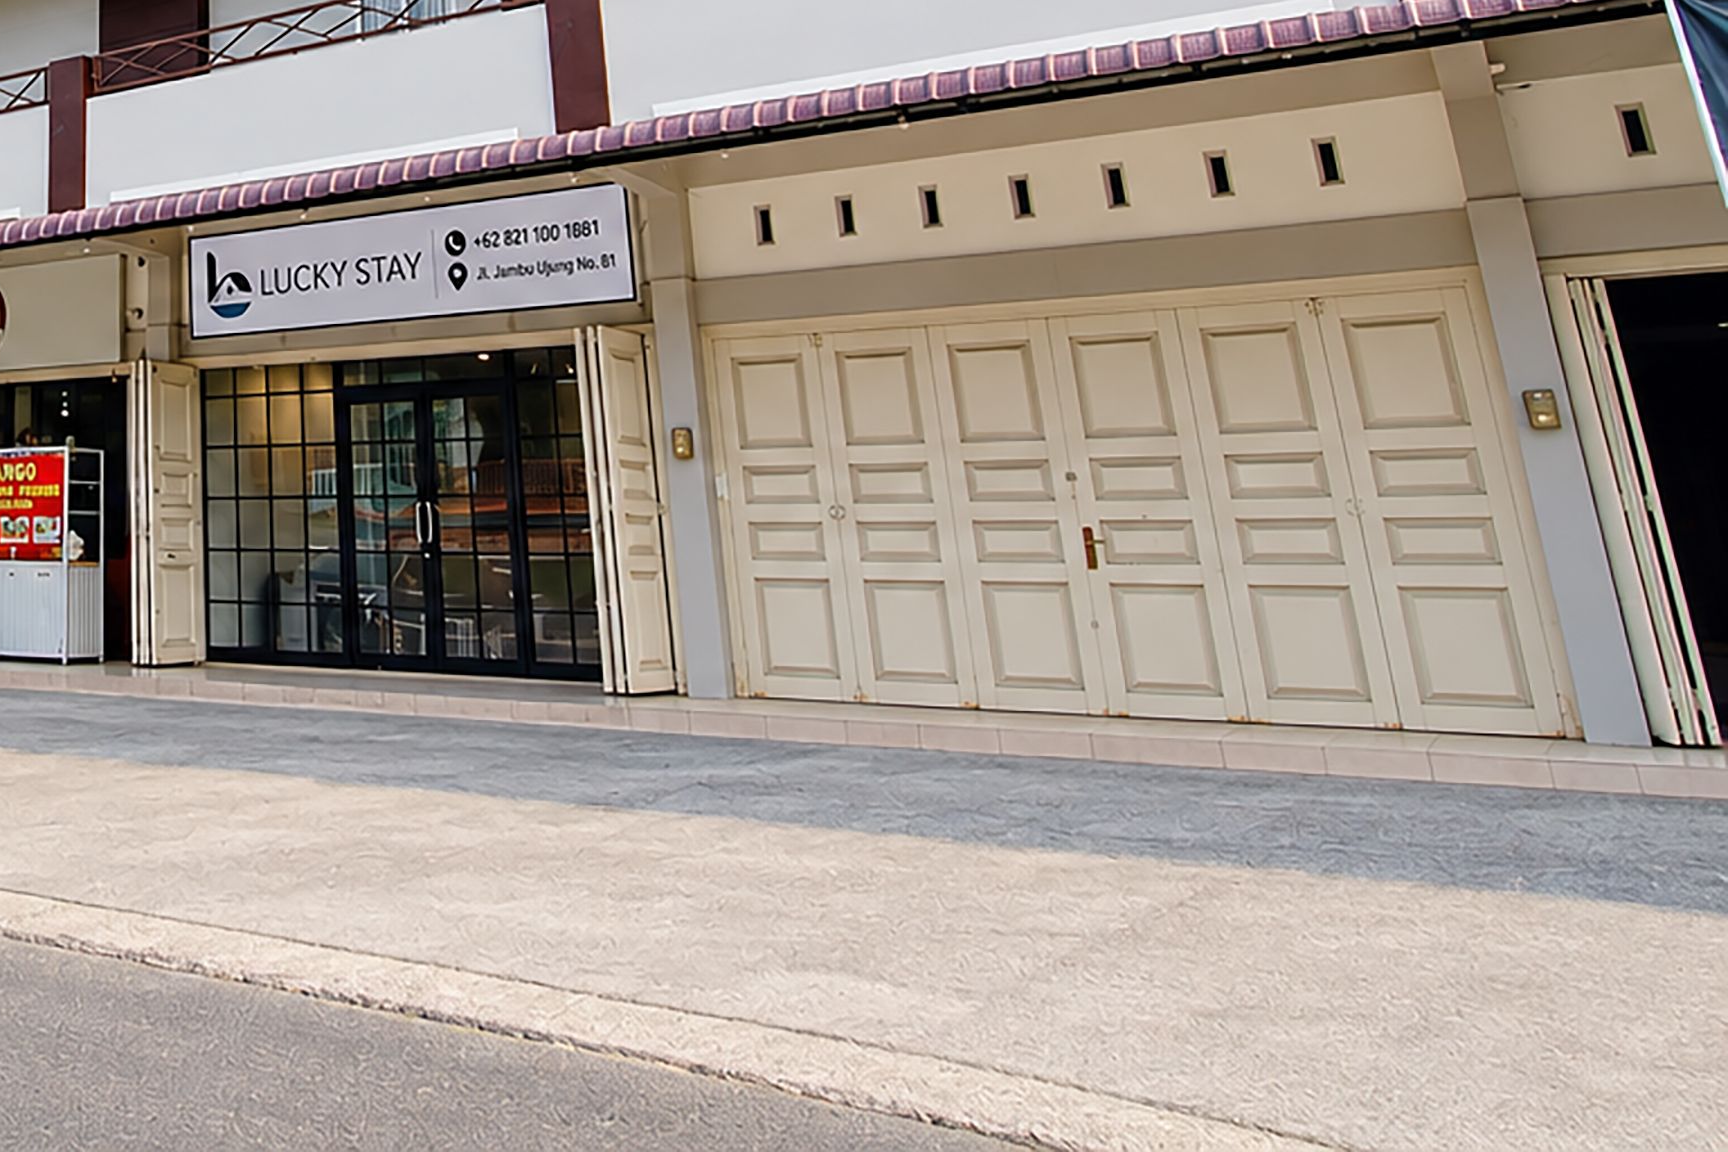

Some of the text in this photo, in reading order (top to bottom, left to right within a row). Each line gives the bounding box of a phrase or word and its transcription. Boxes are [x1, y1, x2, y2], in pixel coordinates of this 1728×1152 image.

[474, 220, 599, 248] +62 821 100 1881
[261, 251, 422, 296] LUCKY STAY
